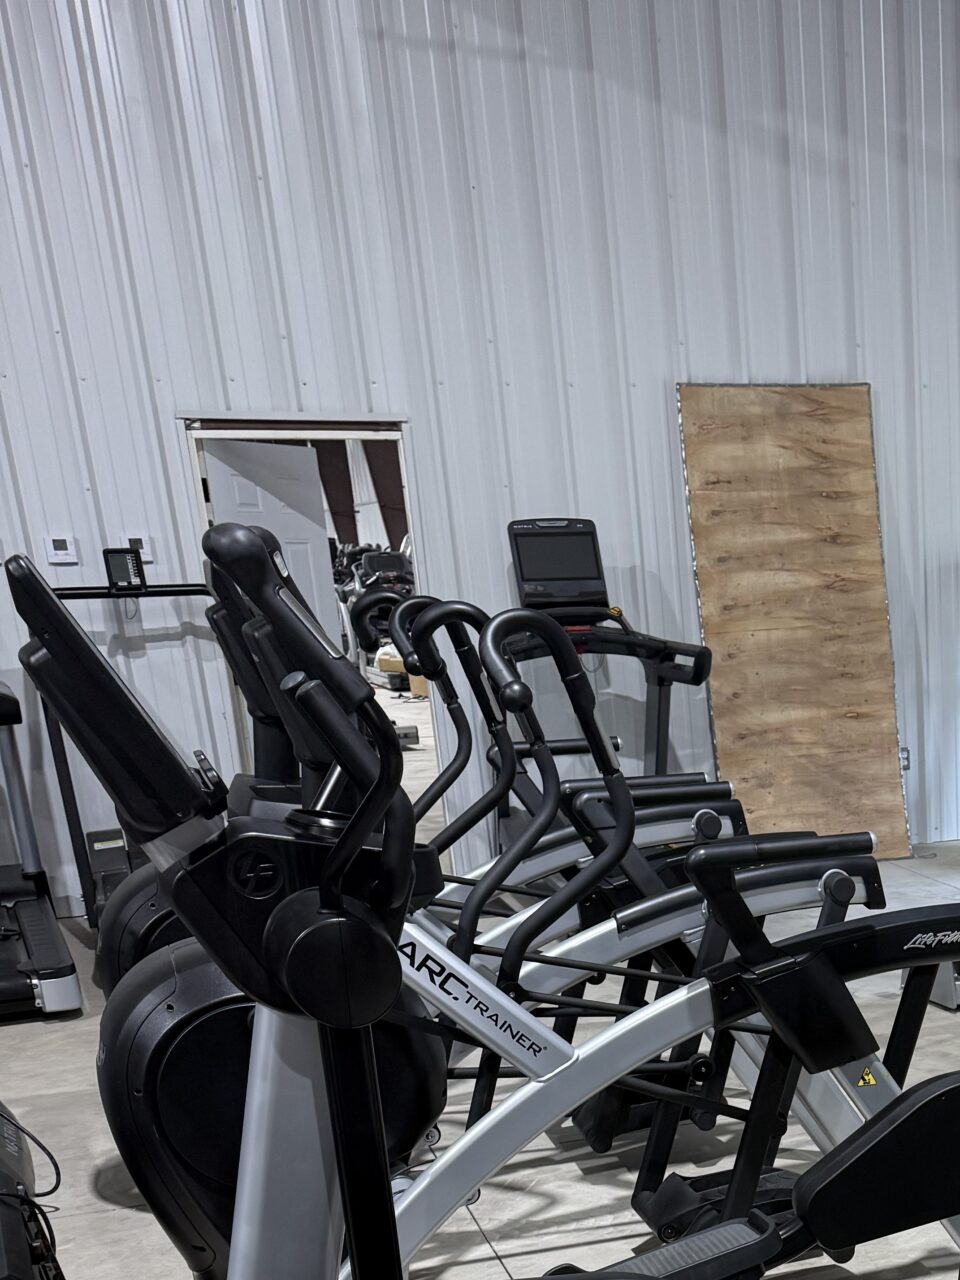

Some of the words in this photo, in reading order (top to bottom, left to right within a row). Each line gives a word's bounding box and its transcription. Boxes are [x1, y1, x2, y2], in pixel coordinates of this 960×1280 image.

[903, 932, 934, 950] Life
[397, 941, 469, 1001] ARC
[465, 991, 544, 1058] TRAINER
